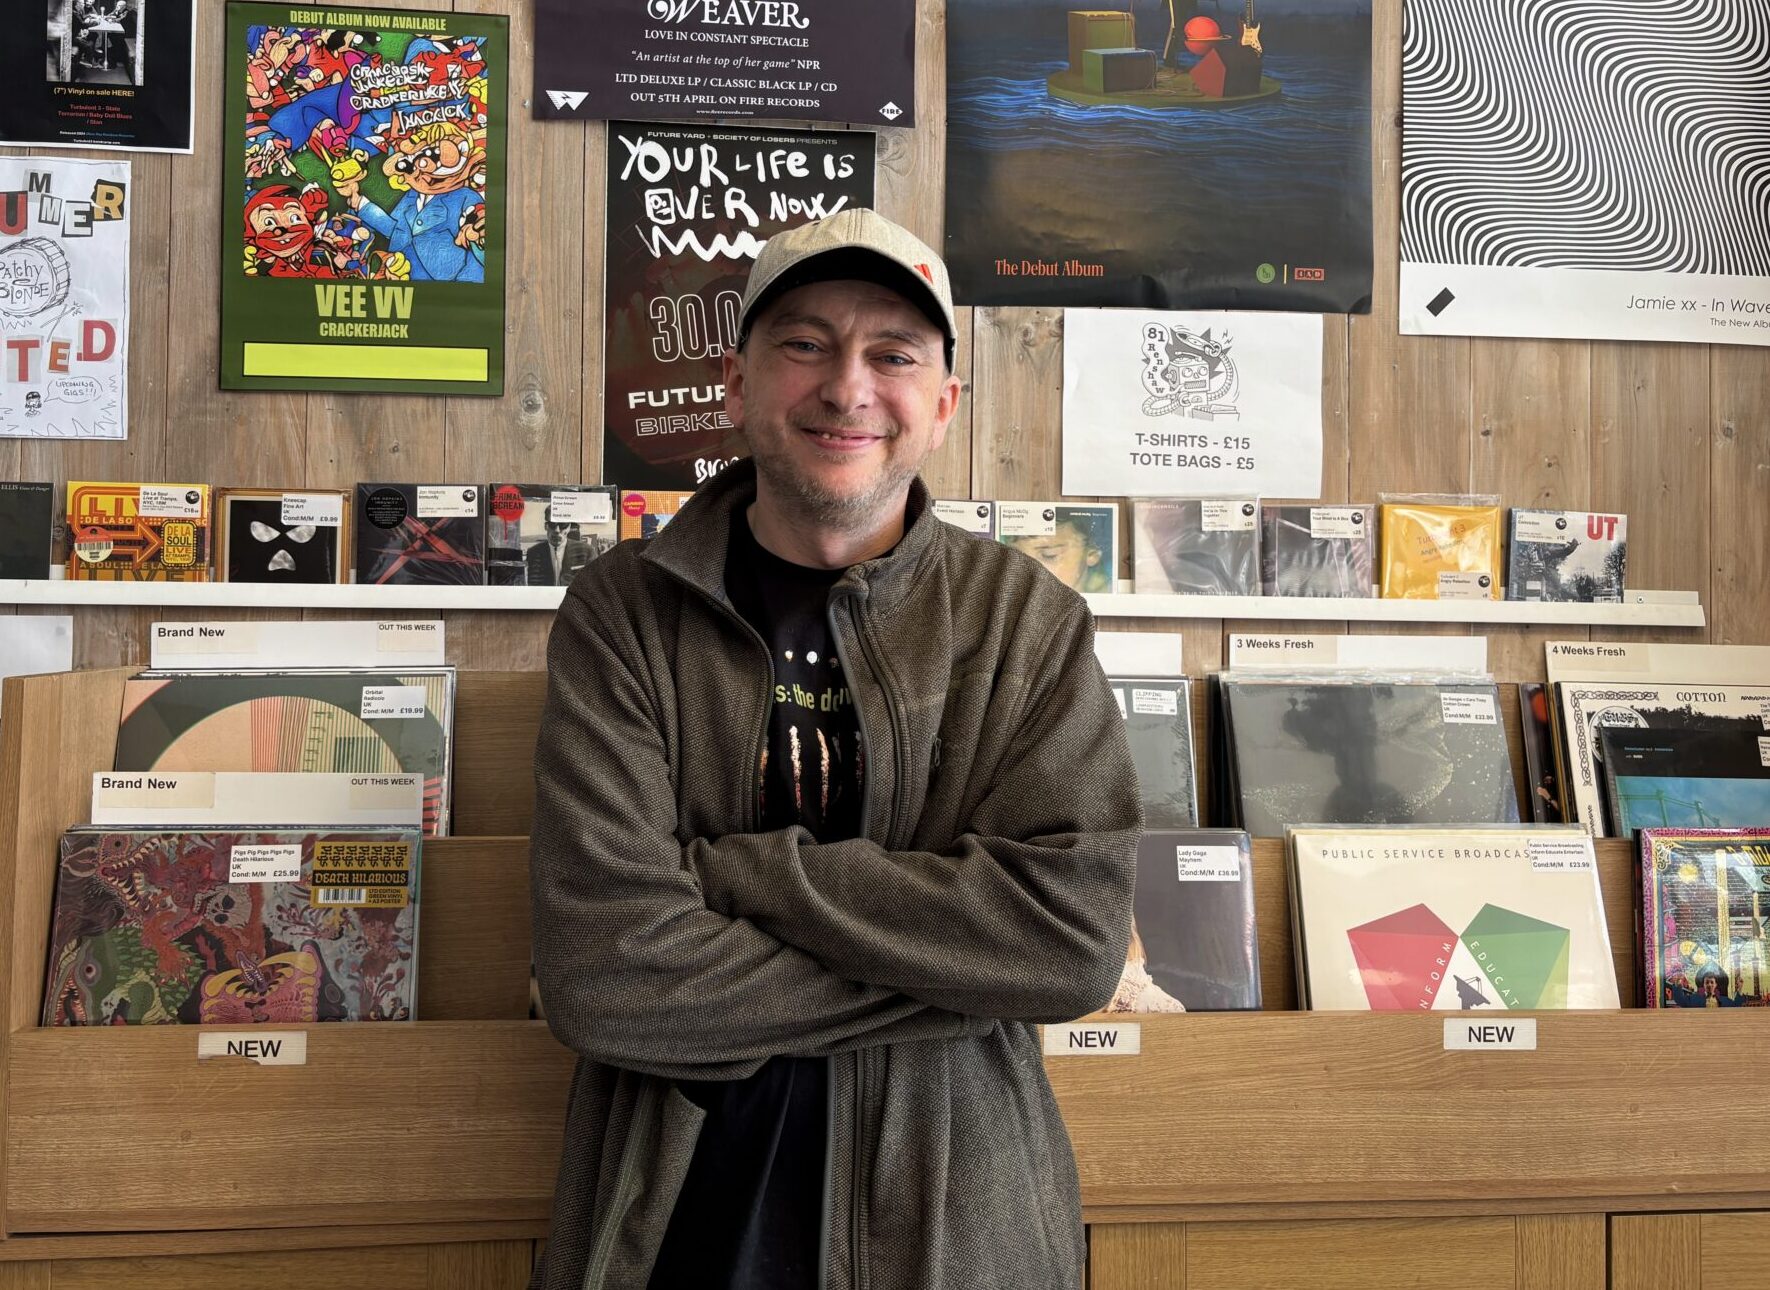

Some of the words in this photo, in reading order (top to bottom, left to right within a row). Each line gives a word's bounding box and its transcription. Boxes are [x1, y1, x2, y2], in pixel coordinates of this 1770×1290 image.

[290, 10, 324, 24] DEBUT
[326, 12, 362, 26] ALBUM
[365, 15, 390, 27] NOW
[392, 16, 447, 31] AVAILABLE
[647, 0, 810, 28] WEAVER
[645, 30, 674, 40] LOVE
[676, 31, 688, 41] IN
[690, 32, 748, 44] CONSTANT
[750, 35, 809, 48] SPECTACLE
[654, 53, 680, 63] artist
[683, 56, 694, 64] at
[696, 54, 712, 65] the
[714, 57, 730, 68] top
[732, 56, 744, 68] of
[744, 57, 761, 67] her
[797, 59, 820, 70] NPR
[616, 73, 637, 83] LTD
[640, 74, 686, 85] DELUXE
[688, 76, 701, 86] LP
[710, 77, 756, 89] CLASSIC
[759, 79, 796, 90] BLACK
[799, 81, 812, 91] LP
[820, 82, 838, 92] CD
[630, 93, 655, 102] OUT
[658, 94, 680, 103] 5TH
[683, 94, 716, 105] APRIL
[719, 95, 737, 105] ON
[740, 96, 764, 106] FIRE
[767, 96, 820, 108] RECORDS
[618, 135, 729, 188] YOUR
[824, 154, 855, 180] IS
[770, 191, 848, 222] NOW
[995, 260, 1018, 275] The
[1022, 261, 1059, 276] Debut
[1063, 262, 1104, 277] Album
[315, 284, 366, 317] VEE
[1626, 295, 1676, 311] Jamie
[1681, 301, 1697, 311] xx
[1711, 298, 1725, 312] In
[320, 322, 409, 338] CRACKERJACK
[650, 291, 742, 362] 30.0
[1710, 318, 1726, 327] The
[1729, 319, 1750, 328] New
[1148, 328, 1165, 342] 81
[1135, 433, 1208, 448] T-SHIRTS
[1224, 436, 1250, 450] £15
[1130, 453, 1172, 467] TOTE
[1178, 454, 1221, 468] BAGS
[1236, 457, 1255, 470] £5
[167, 526, 178, 535] DE
[180, 526, 190, 536] LA
[1587, 515, 1618, 540] UT
[166, 536, 191, 545] SOUL
[158, 627, 194, 638] Brand
[199, 627, 225, 638] New
[1237, 639, 1242, 648] 3
[1246, 639, 1280, 649] Weeks
[1284, 639, 1314, 649] Fresh
[1560, 646, 1595, 655] Weeks
[1597, 647, 1626, 656] Fresh
[793, 684, 814, 709] the
[101, 778, 142, 789] Brand
[148, 778, 177, 789] New
[1322, 849, 1374, 859] PUBLIC
[1384, 849, 1445, 859] SERVICE
[1455, 850, 1530, 859] BROADCAS
[315, 873, 349, 884] DEATH
[352, 873, 406, 883] HILARIOUS
[1420, 941, 1451, 1009] NFORM
[1470, 940, 1519, 1008] EDUCAT
[1069, 1031, 1118, 1048] NEW
[1468, 1027, 1515, 1044] NEW
[228, 1040, 282, 1057] NEW
